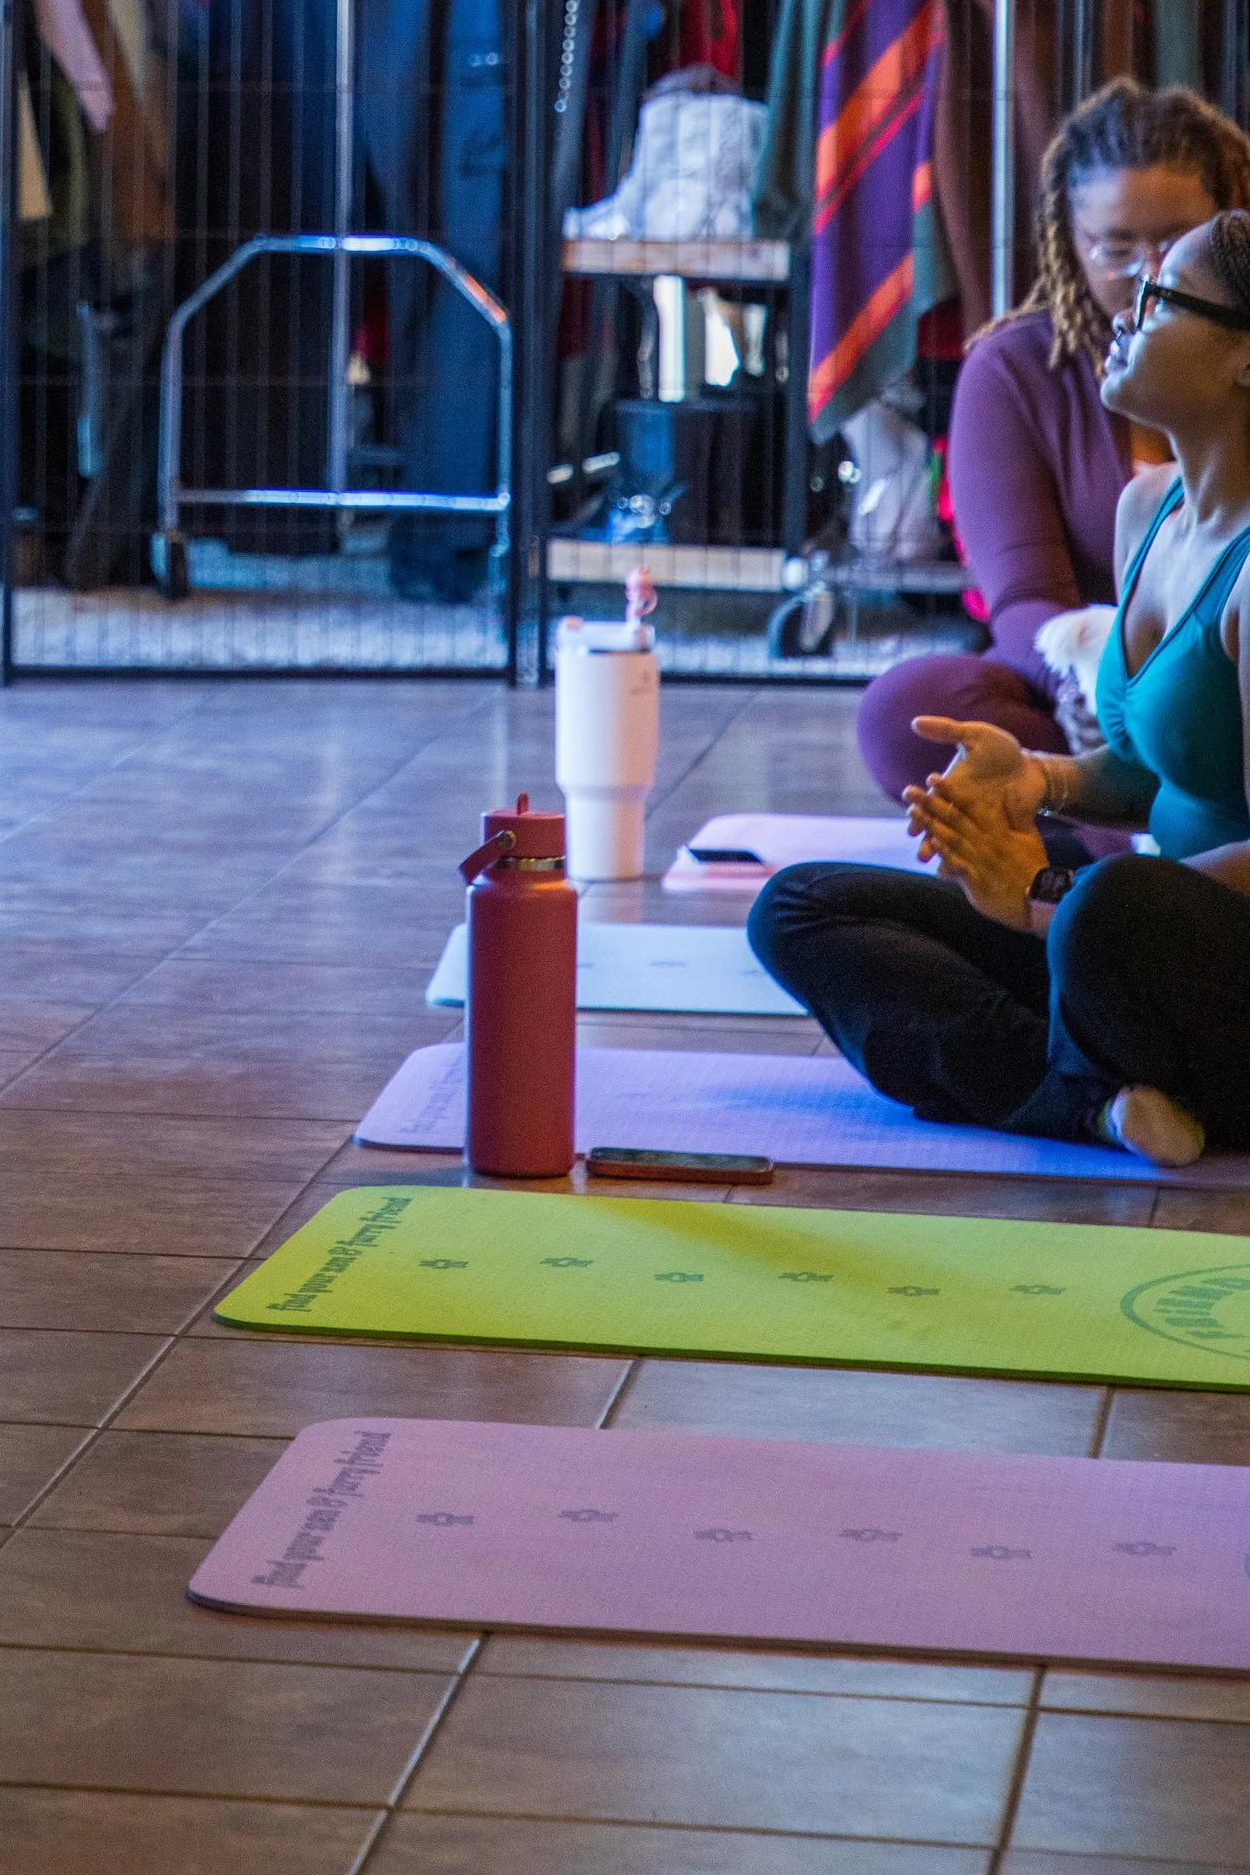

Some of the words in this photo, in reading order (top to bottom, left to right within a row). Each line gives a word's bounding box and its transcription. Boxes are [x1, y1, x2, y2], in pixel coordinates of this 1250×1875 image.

[358, 1197, 413, 1224] friend
[335, 1224, 397, 1248] furry
[333, 1430, 392, 1467] friend
[312, 1466, 381, 1499] furry
